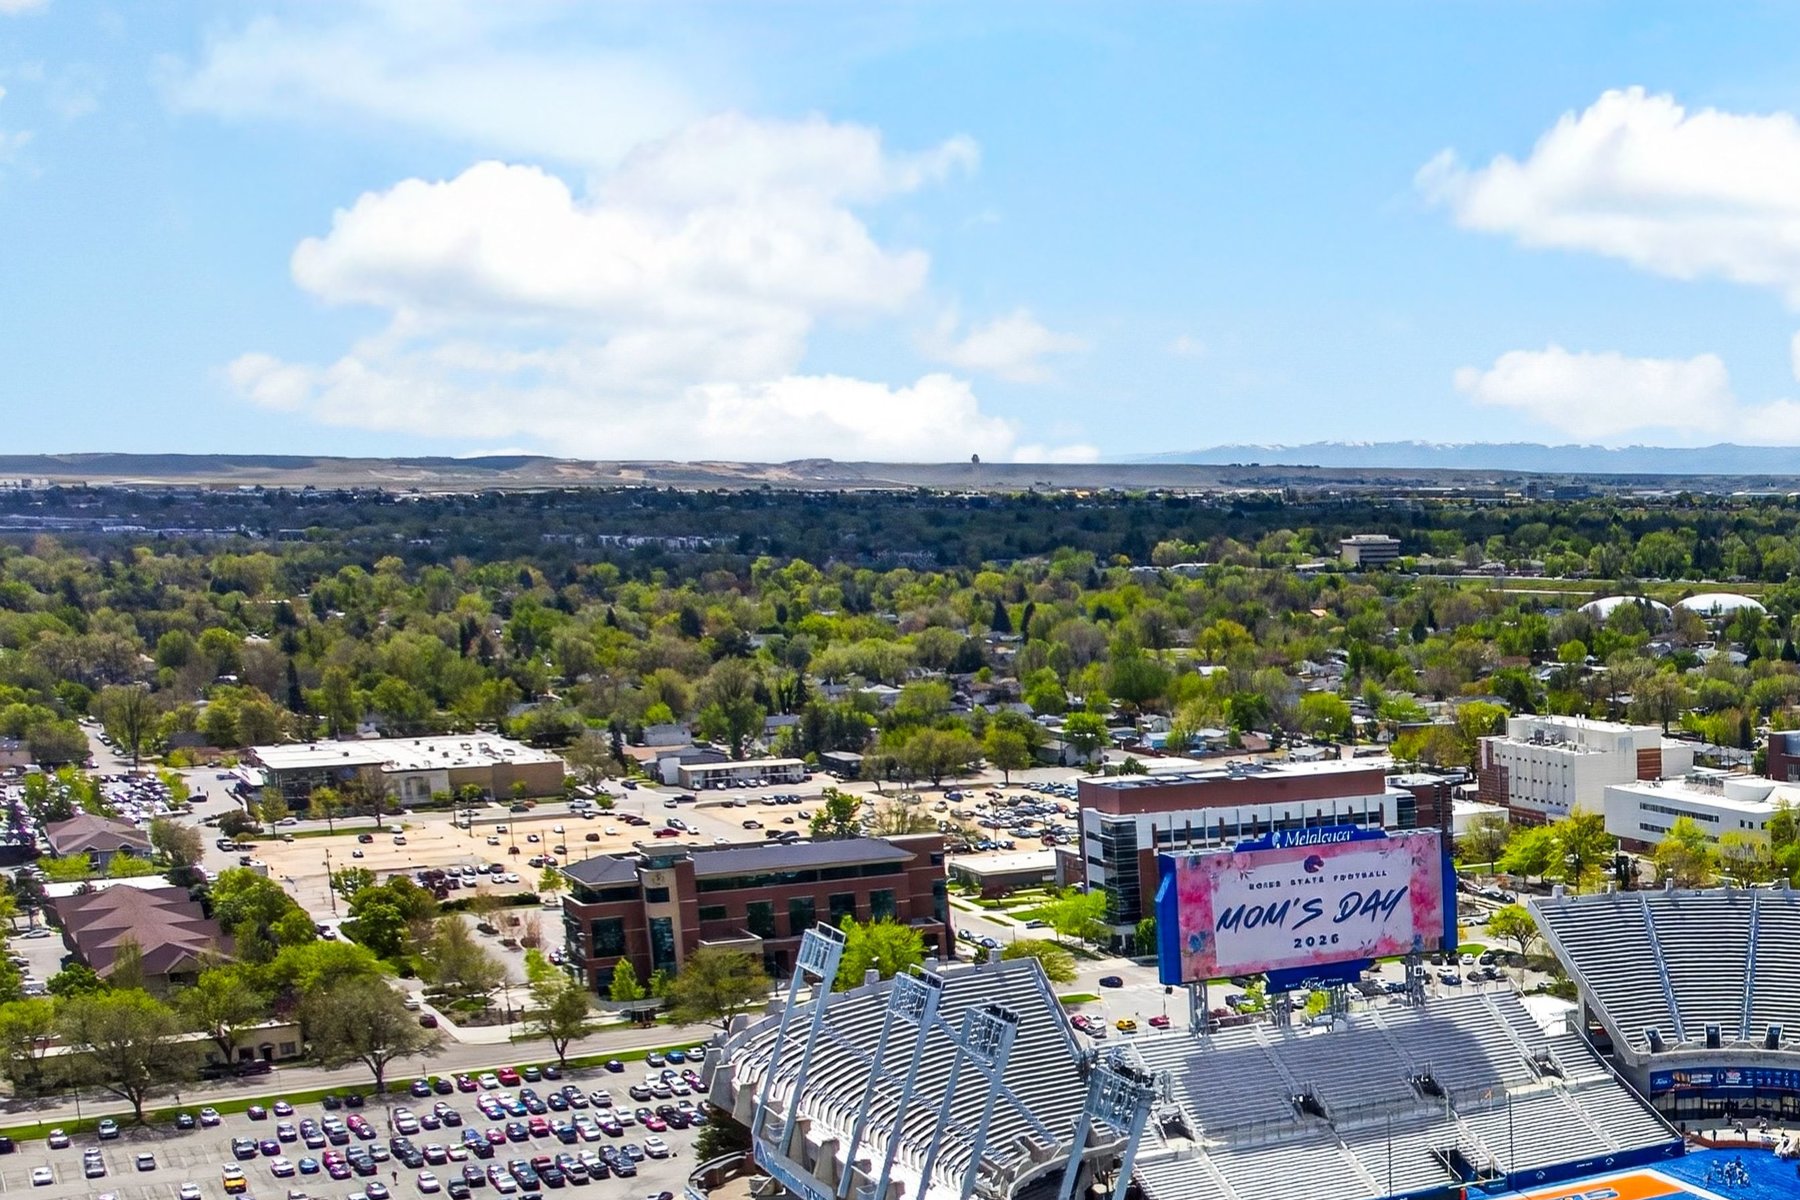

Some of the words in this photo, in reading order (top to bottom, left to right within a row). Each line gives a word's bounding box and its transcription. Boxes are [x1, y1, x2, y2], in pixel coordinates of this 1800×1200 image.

[1284, 827, 1351, 848] Melaleuca
[1333, 870, 1387, 882] FOOTBALL
[1216, 897, 1323, 934] MOM'S
[1332, 886, 1408, 923] DAY
[1293, 934, 1340, 949] 2026
